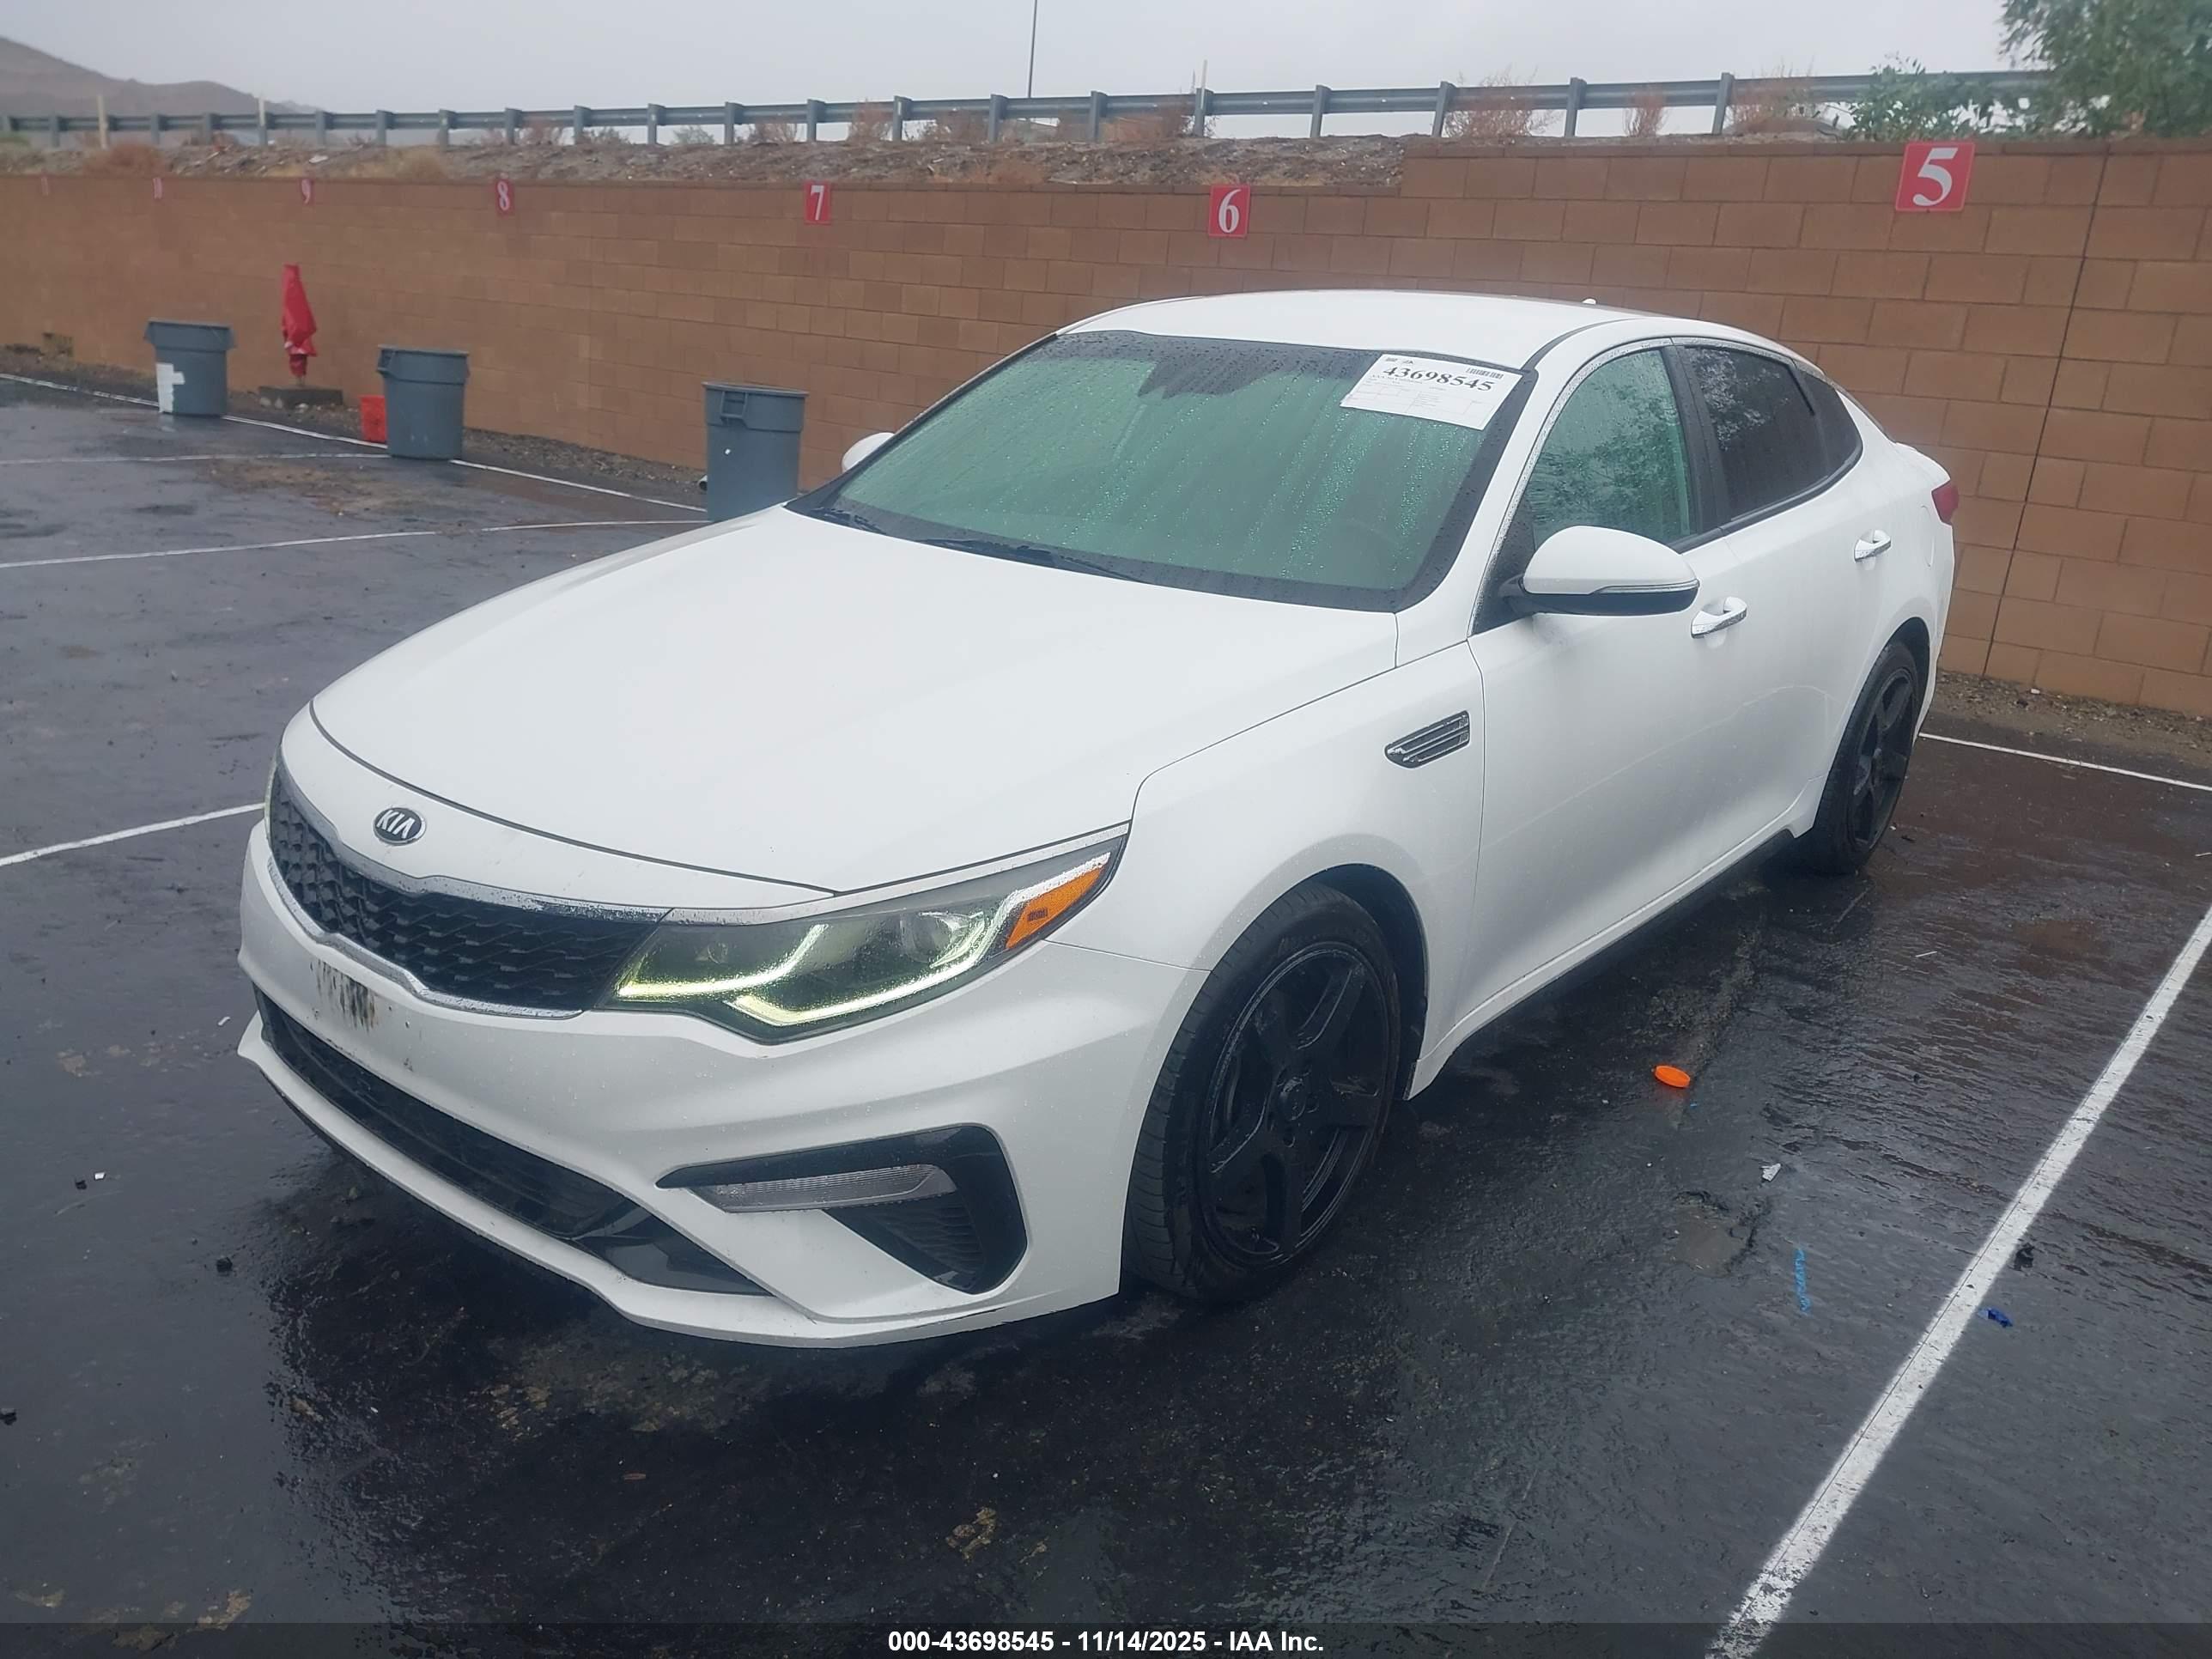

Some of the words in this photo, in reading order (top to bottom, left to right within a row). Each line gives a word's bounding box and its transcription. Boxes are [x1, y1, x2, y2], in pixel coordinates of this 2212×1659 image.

[1912, 147, 1959, 206] 5
[497, 180, 511, 211] 8
[810, 185, 825, 221] 7
[1218, 188, 1242, 234] 6
[1382, 366, 1495, 392] 43698545
[376, 810, 416, 839] KIA
